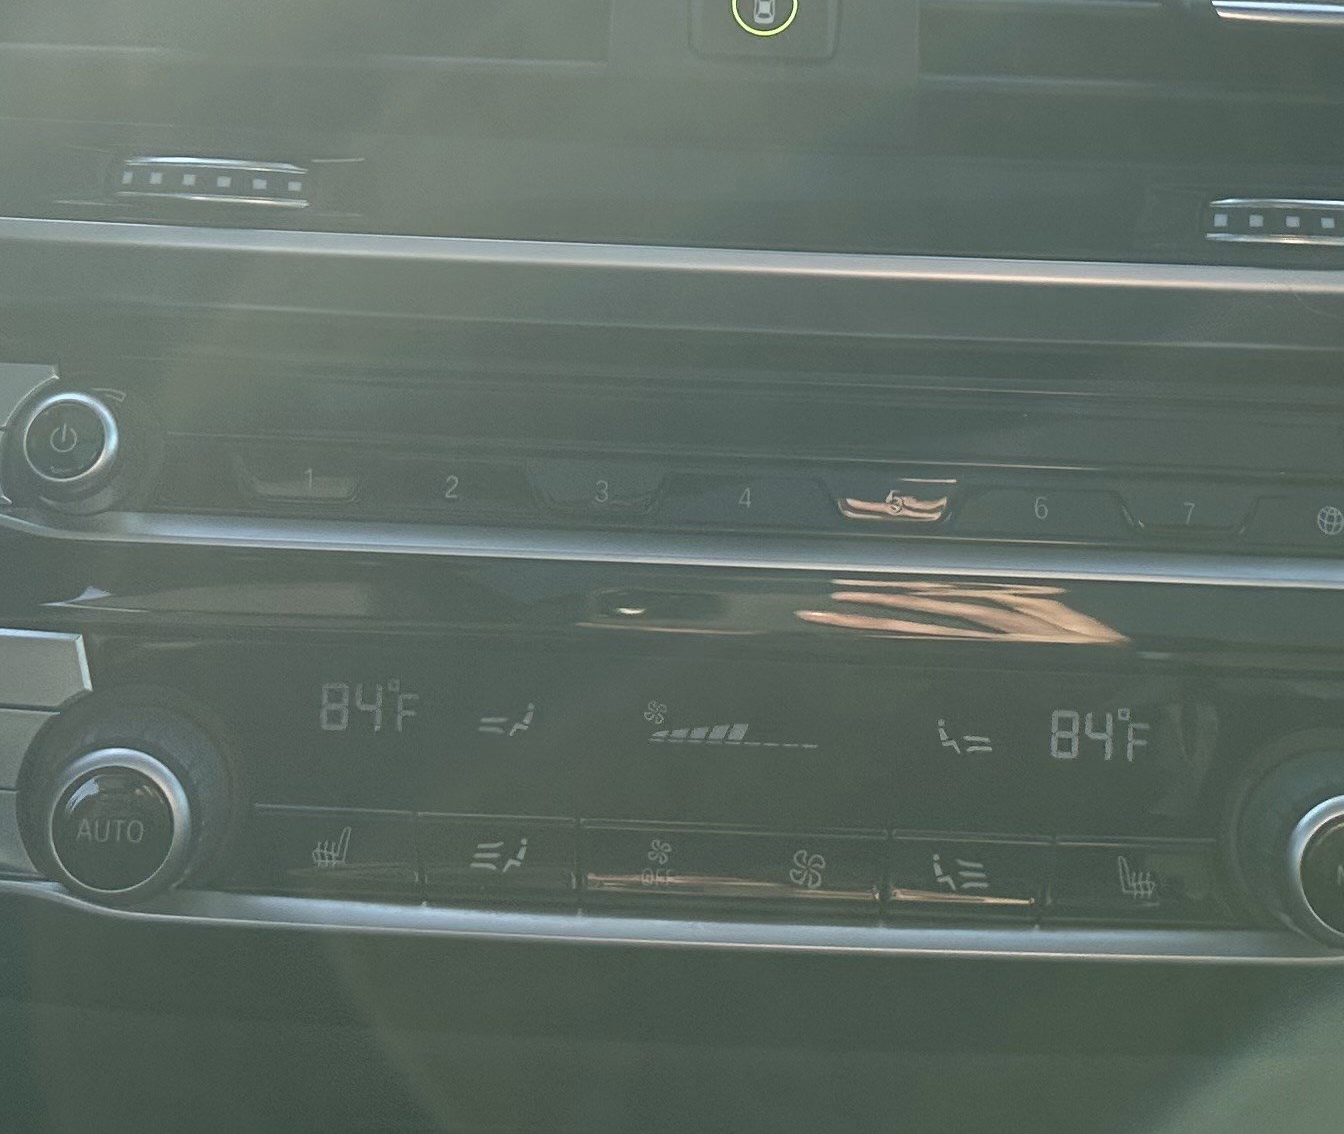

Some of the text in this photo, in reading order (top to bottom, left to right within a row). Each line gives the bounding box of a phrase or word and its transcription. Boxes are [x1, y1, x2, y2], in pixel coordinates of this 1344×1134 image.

[444, 475, 461, 501] 2
[595, 479, 609, 503] 3
[737, 487, 753, 509] 4
[1034, 496, 1049, 521] 6
[1183, 501, 1196, 525] 7
[75, 818, 145, 846] AUTO
